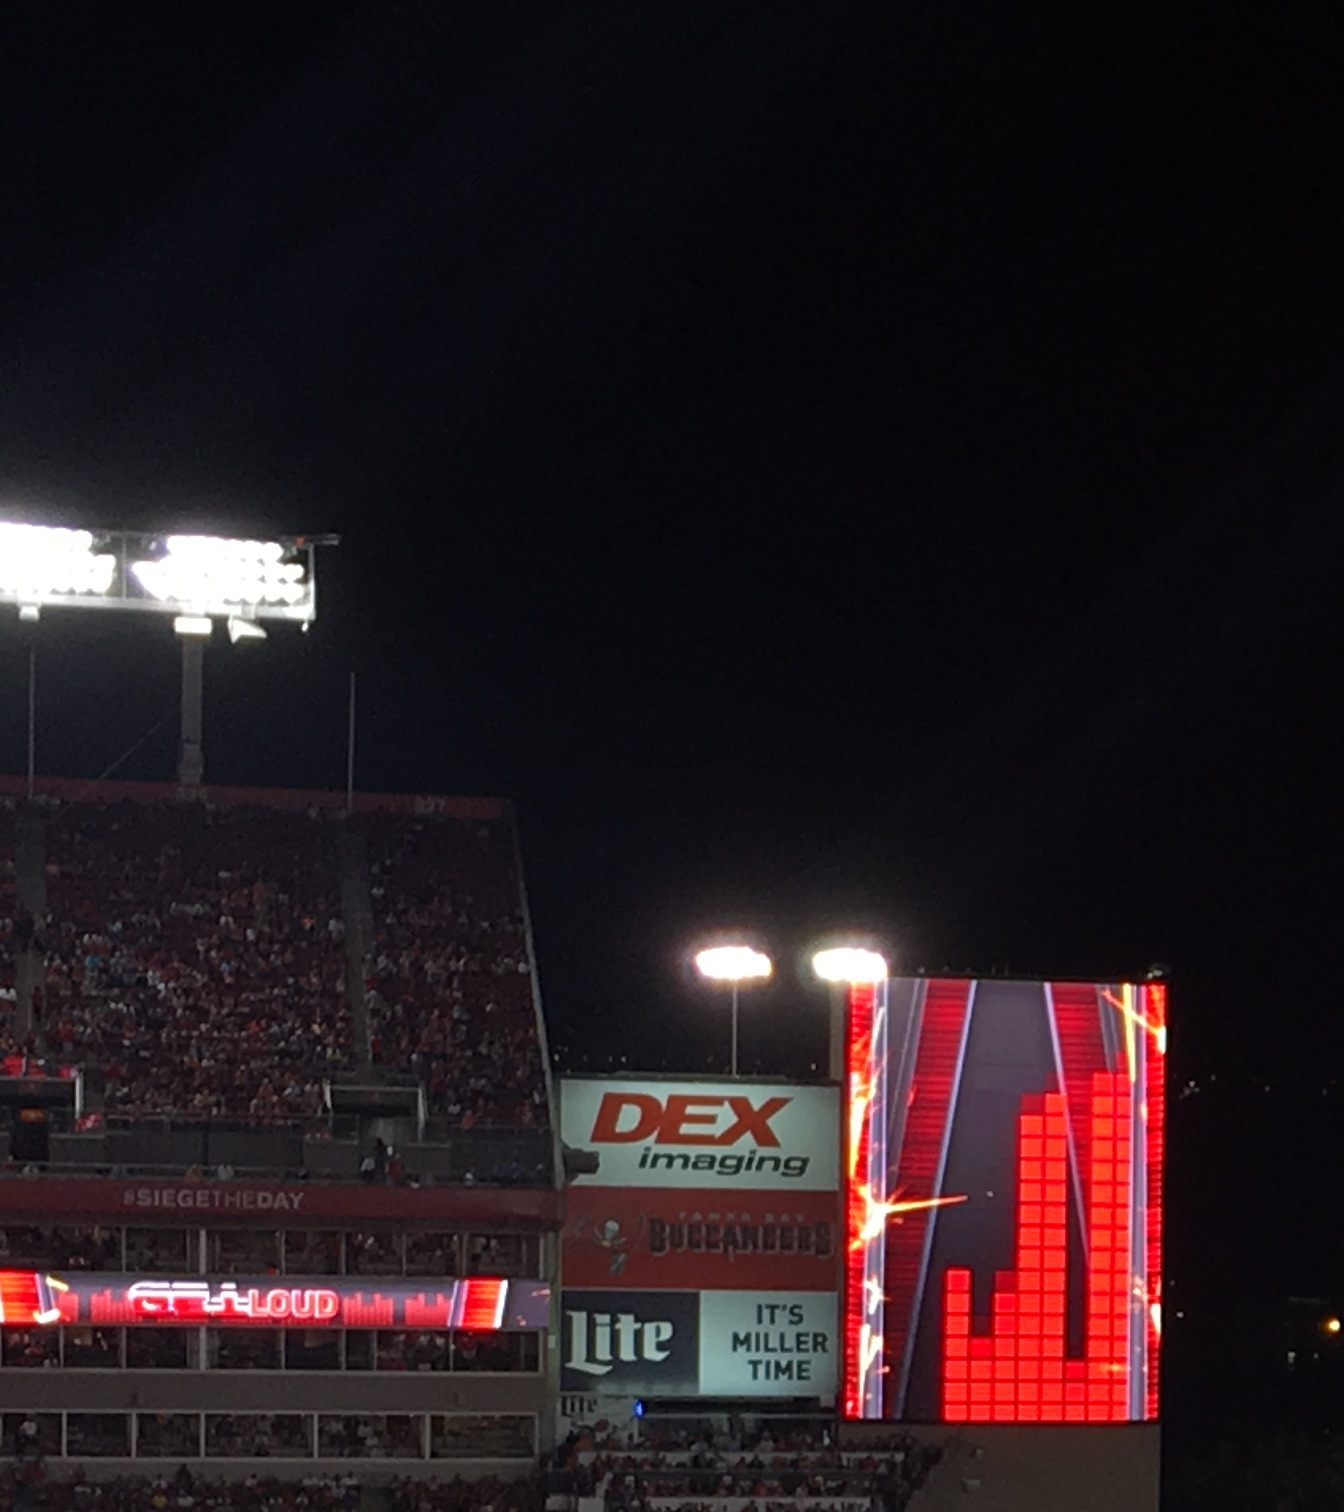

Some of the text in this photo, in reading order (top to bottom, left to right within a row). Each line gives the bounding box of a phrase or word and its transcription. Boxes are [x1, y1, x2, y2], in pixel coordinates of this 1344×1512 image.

[590, 1091, 795, 1149] DEX
[637, 1144, 811, 1178] imaging
[123, 1188, 305, 1211] #SIEGETHEDAY
[648, 1217, 835, 1263] BUCCANEERS
[247, 1288, 340, 1319] LOUD
[756, 1304, 805, 1325] IT'S
[565, 1310, 674, 1376] Lite
[731, 1331, 829, 1356] MILLER
[747, 1359, 812, 1382] TIME
